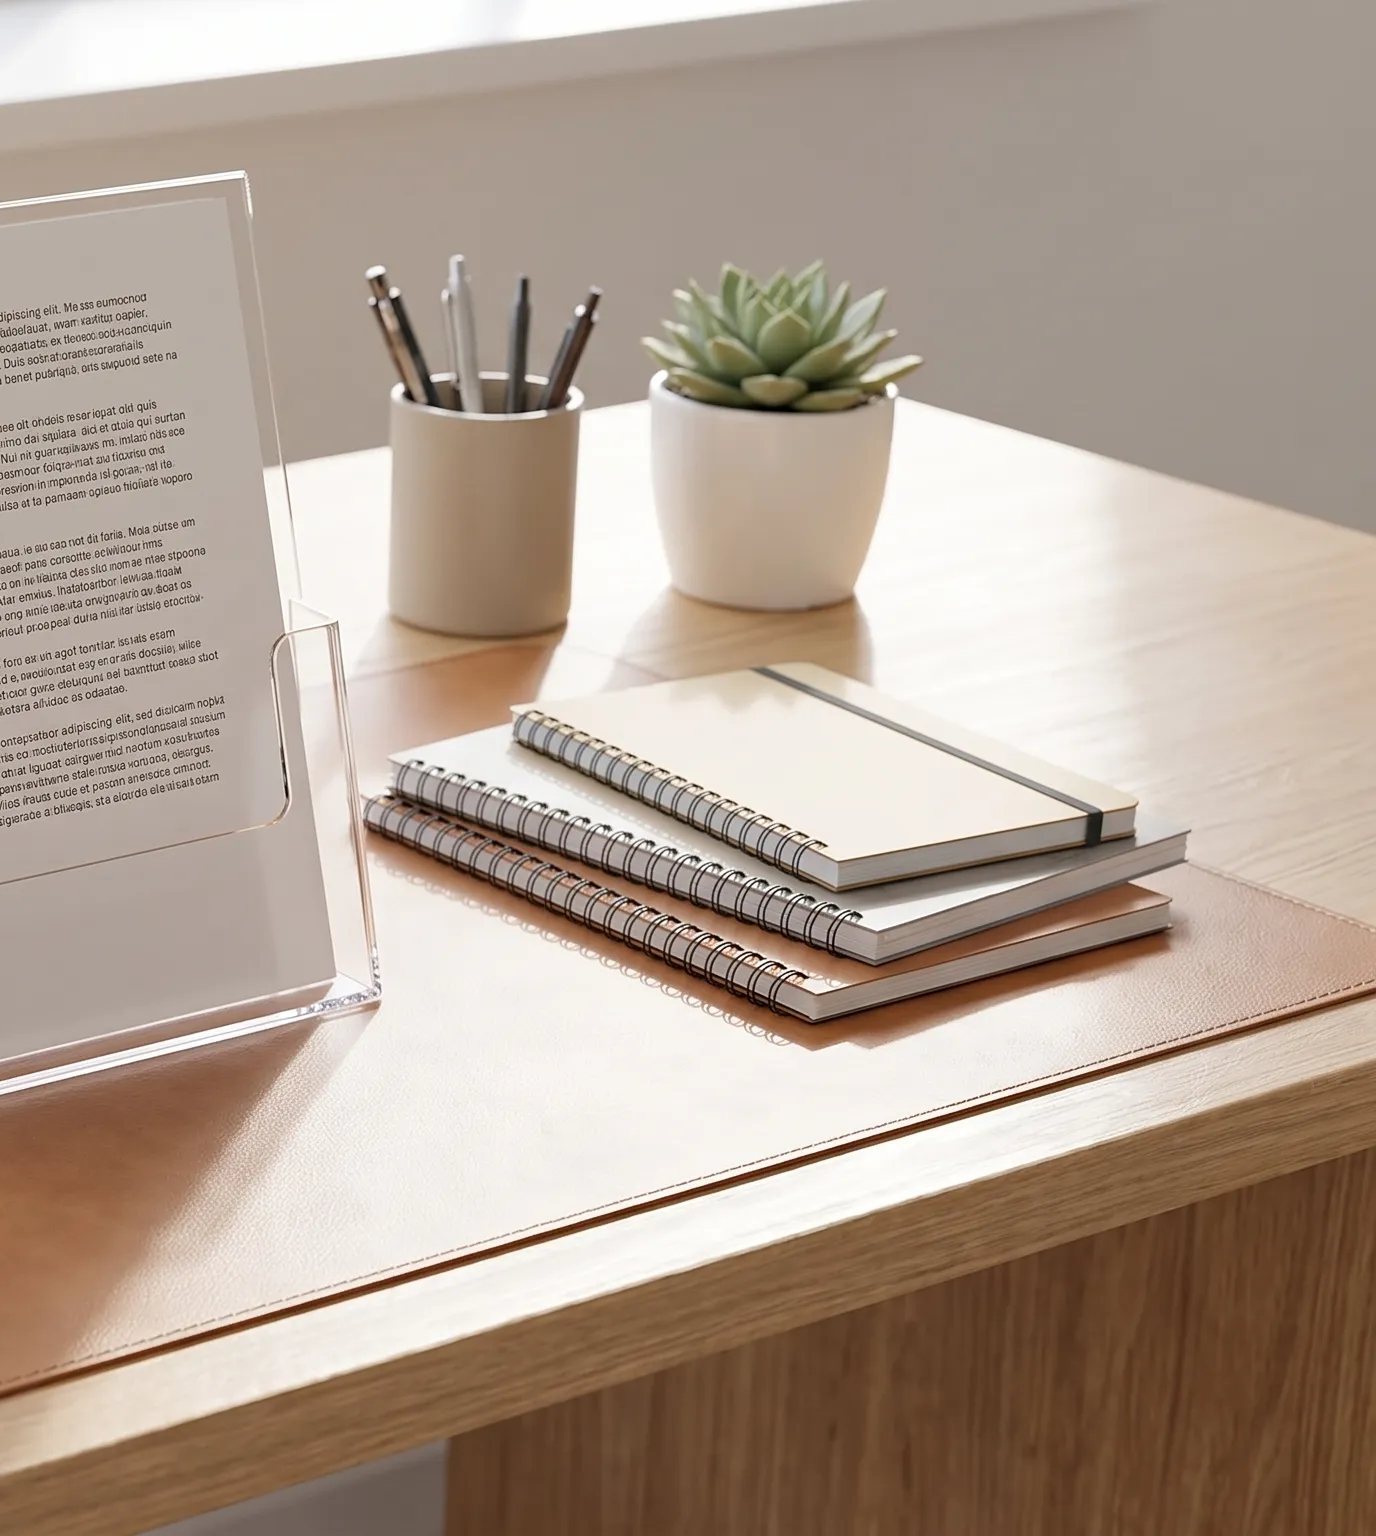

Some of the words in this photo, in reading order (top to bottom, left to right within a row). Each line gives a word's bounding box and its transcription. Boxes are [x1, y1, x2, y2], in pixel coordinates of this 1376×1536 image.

[42, 303, 62, 317] elit.
[50, 337, 63, 347] ex
[3, 356, 26, 370] Duis
[165, 351, 178, 361] na
[136, 399, 158, 414] quis
[98, 423, 110, 434] et
[136, 414, 153, 429] qui
[61, 717, 113, 737] adipiscing
[115, 712, 135, 725] elit,
[135, 708, 154, 722] sed
[79, 783, 91, 795] et
